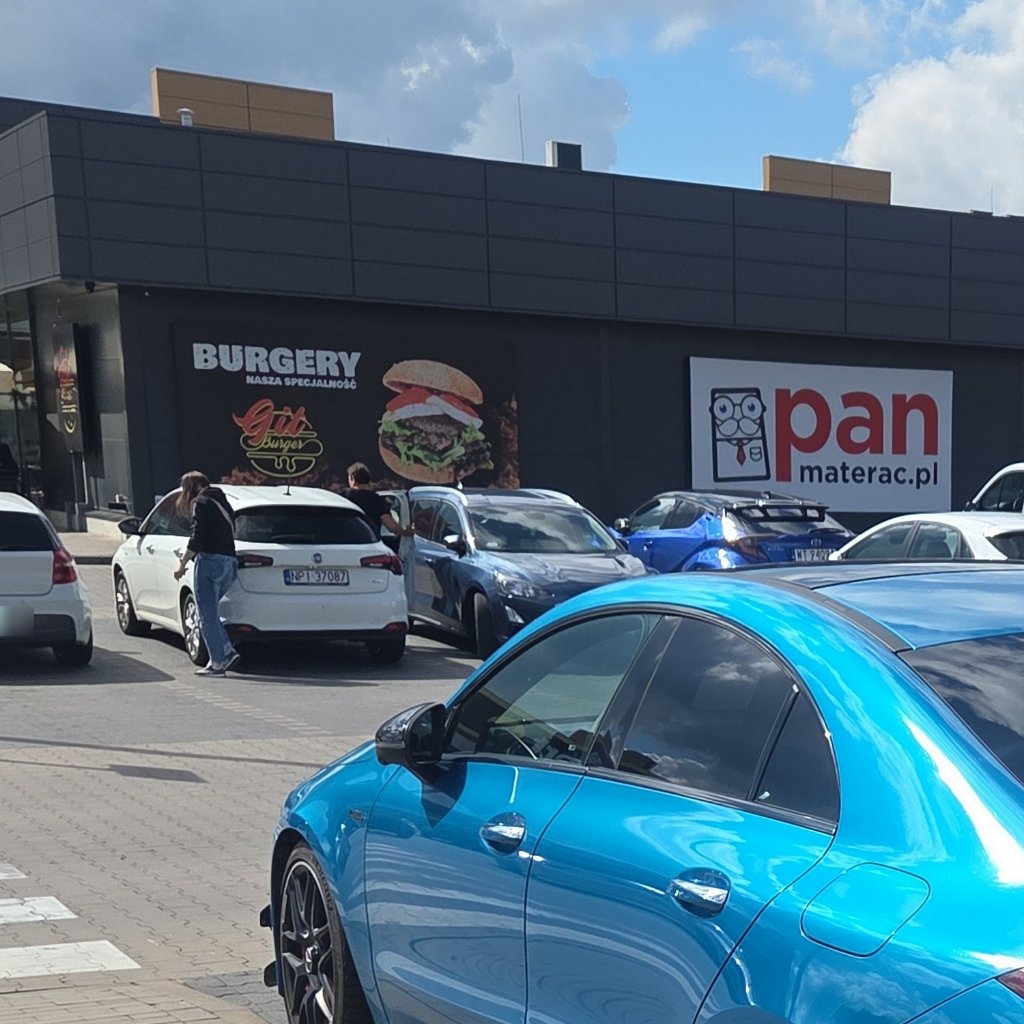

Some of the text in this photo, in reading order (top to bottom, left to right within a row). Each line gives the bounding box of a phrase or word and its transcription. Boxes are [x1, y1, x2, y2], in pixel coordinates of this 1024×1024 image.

[192, 342, 361, 377] BURGERY
[246, 375, 357, 389] NASZA SPECJALNOŚĆ
[232, 398, 307, 445] Git
[774, 388, 939, 482] pan
[260, 435, 304, 454] Burger
[800, 461, 938, 489] materac.pl
